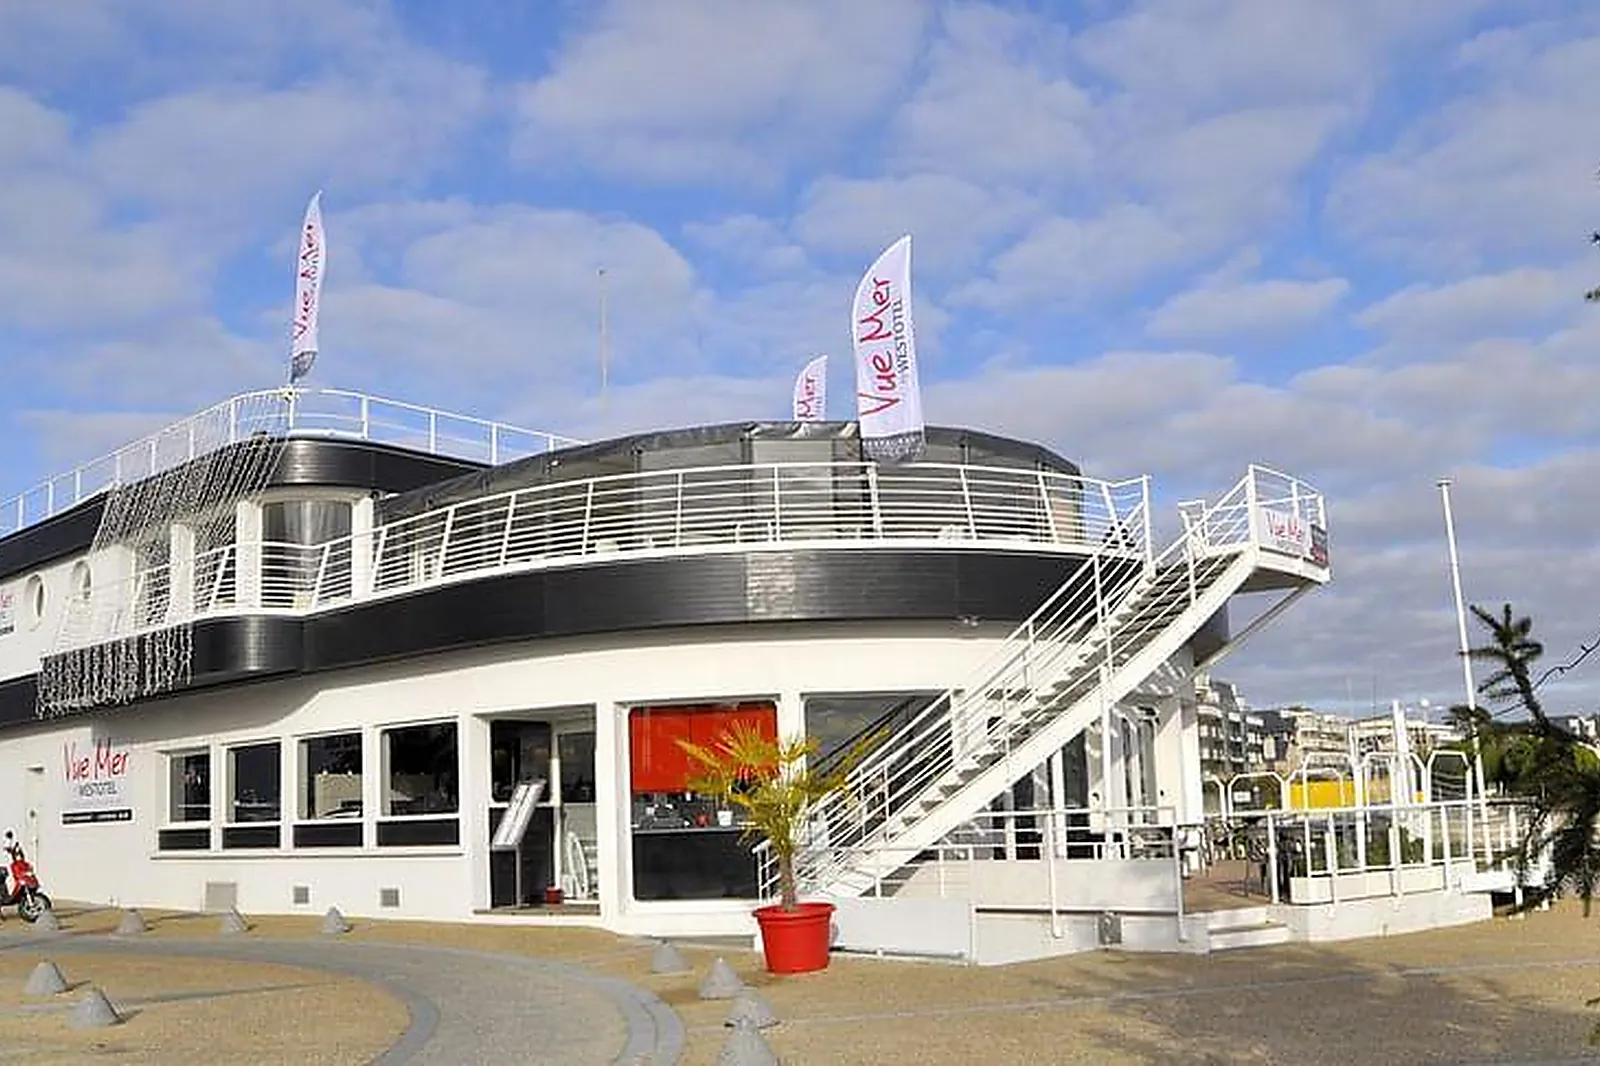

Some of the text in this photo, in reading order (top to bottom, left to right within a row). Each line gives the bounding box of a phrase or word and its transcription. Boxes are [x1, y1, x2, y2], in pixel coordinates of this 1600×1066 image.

[301, 224, 320, 277] Mer
[294, 288, 309, 340] Vue
[857, 277, 900, 416] Vue Mer
[64, 737, 129, 781] Vue Mer
